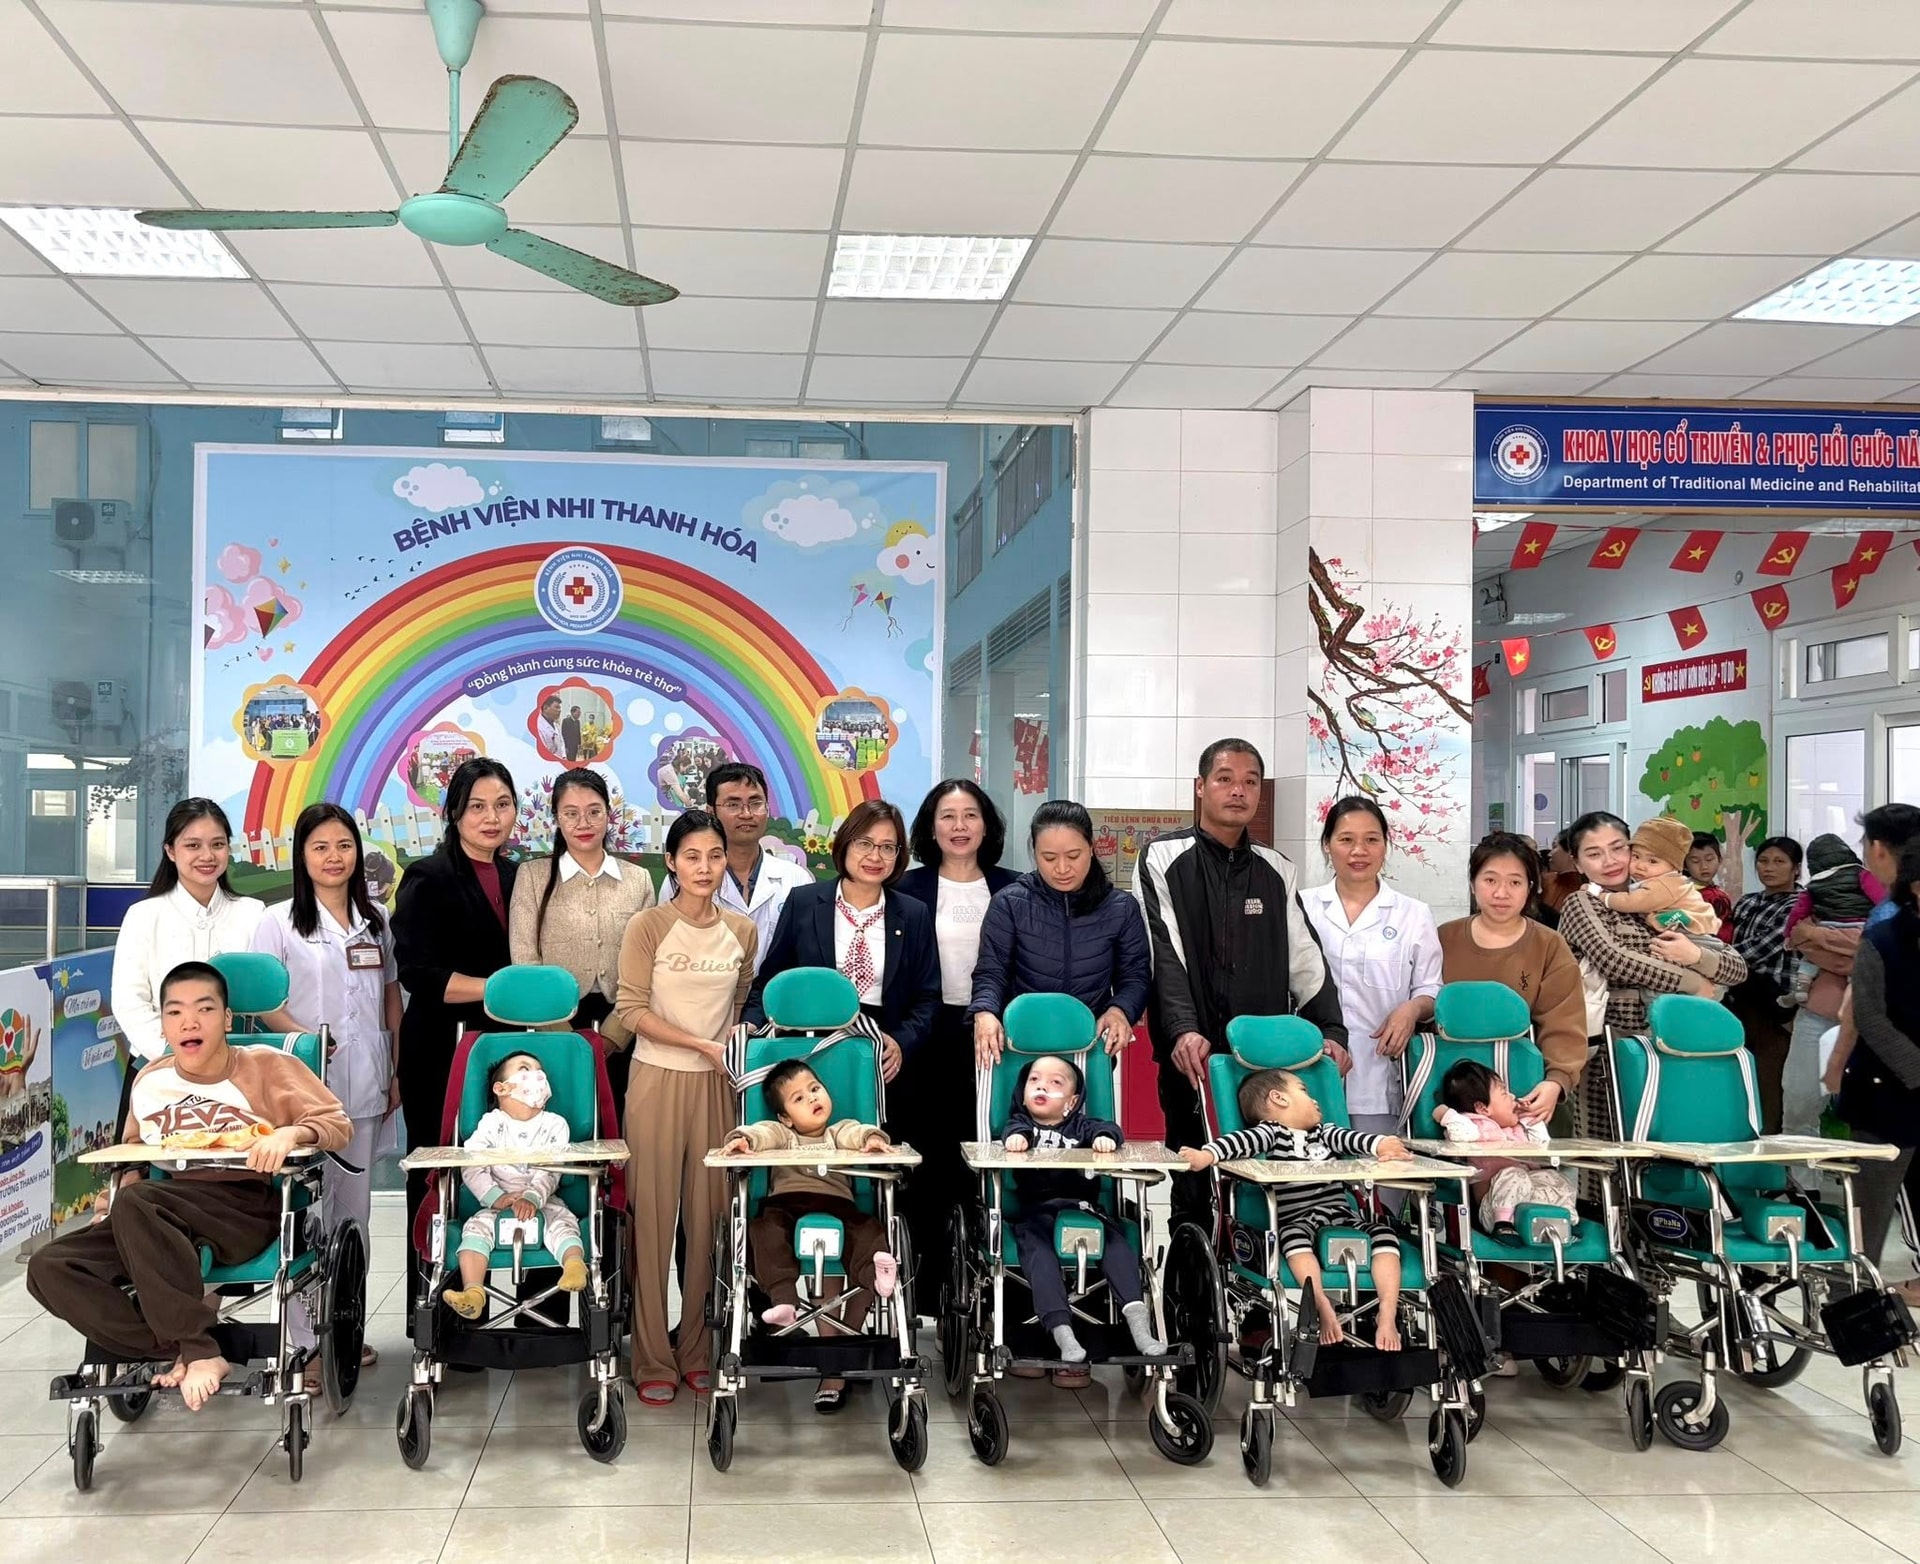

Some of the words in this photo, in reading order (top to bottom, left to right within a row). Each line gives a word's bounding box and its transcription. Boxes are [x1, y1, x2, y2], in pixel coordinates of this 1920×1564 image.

[1563, 430, 1609, 463] KHOA
[1611, 430, 1624, 463] Y
[1626, 430, 1661, 470] HỌC
[1664, 418, 1687, 463] CỔ
[1689, 421, 1752, 465] TRUYỀN
[1756, 433, 1770, 465] &
[1773, 433, 1818, 472] PHỤC
[1821, 424, 1848, 467] HỒI
[1852, 429, 1893, 468] CHỨC
[1896, 429, 1920, 469] NĂ
[1563, 475, 1647, 491] Department
[1652, 476, 1667, 489] of
[1670, 476, 1746, 491] Traditional
[1750, 477, 1814, 492] Medicine
[1818, 479, 1844, 492] and
[393, 511, 471, 553] BỆNH
[474, 495, 540, 528] VIỆN
[546, 497, 594, 520] NHI
[600, 498, 698, 538] THANH
[700, 521, 759, 564] HÓA
[508, 659, 541, 676] hành
[543, 656, 574, 670] cùng
[576, 656, 600, 669] sức
[602, 658, 632, 676] khỏe
[634, 668, 654, 683] trẻ
[655, 952, 741, 972] Believ
